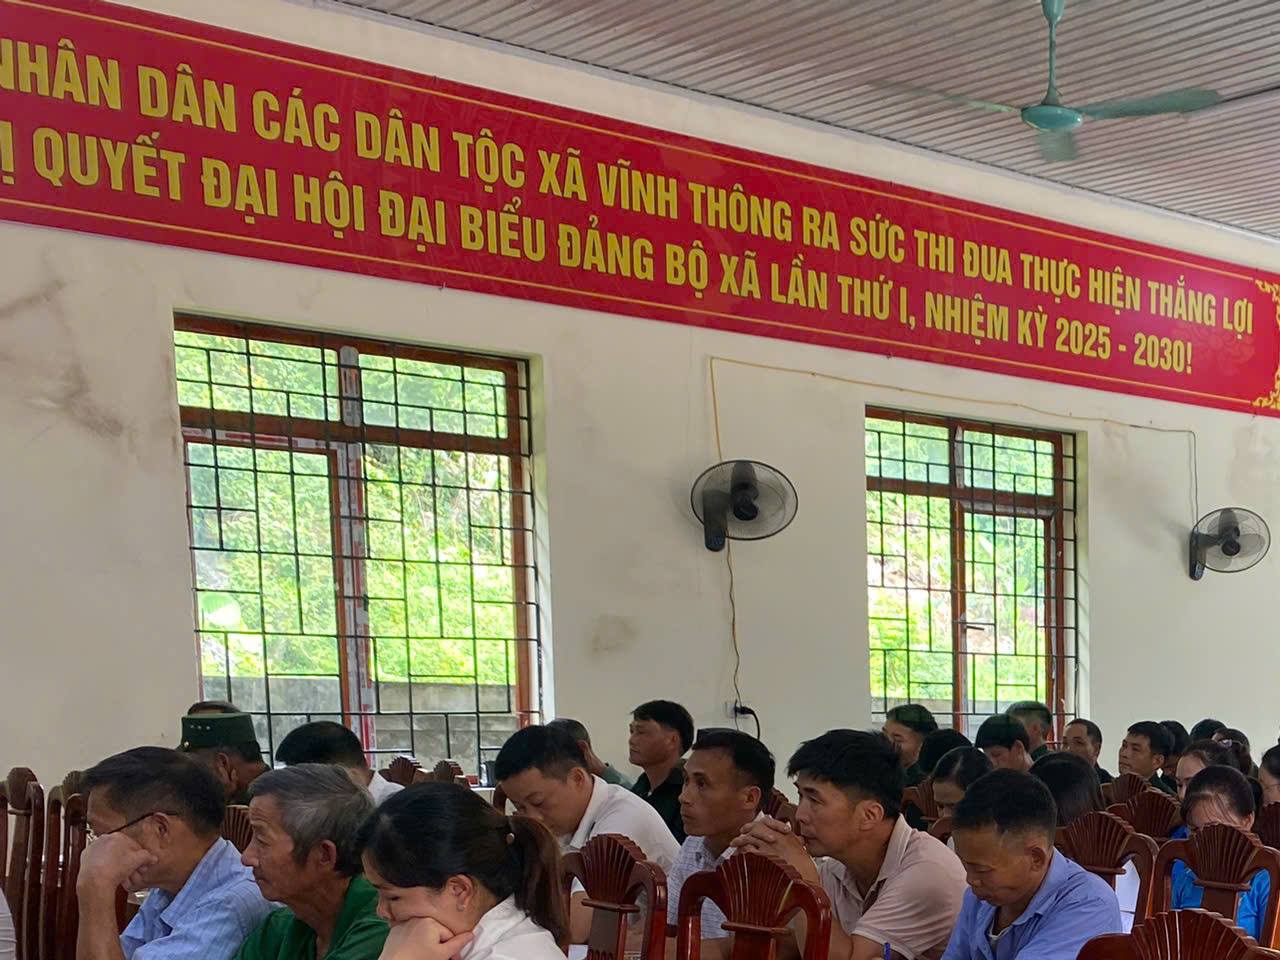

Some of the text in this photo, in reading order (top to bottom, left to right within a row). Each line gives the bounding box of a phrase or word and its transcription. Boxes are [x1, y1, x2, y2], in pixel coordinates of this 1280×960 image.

[33, 130, 186, 202] QUYẾT
[200, 157, 278, 225] ĐẠI
[292, 170, 365, 240] HỘI
[379, 190, 447, 253] ĐẠI
[460, 196, 546, 262] BIỂU
[557, 214, 656, 283] ĐẢNG
[665, 240, 710, 299] BỘ
[719, 252, 761, 300] XÃ
[771, 252, 828, 311] LẦN
[836, 268, 894, 322] THỨ
[899, 286, 917, 330] I,
[924, 292, 1011, 347] NHIỆM
[1017, 307, 1050, 350] KỲ
[1055, 316, 1112, 361] 2025
[1134, 333, 1194, 374] 2030!
[137, 63, 237, 133] DÂN
[252, 87, 341, 152] CÁC
[355, 108, 441, 173] DÂN
[452, 128, 526, 193] TỘC
[538, 147, 587, 202] XÃ
[597, 158, 679, 220] VĨNH
[688, 180, 793, 242] THÔNG
[802, 207, 841, 252] RA
[849, 213, 905, 264] SỨC
[913, 230, 955, 273] THI
[962, 239, 1013, 286] ĐUA
[1020, 254, 1081, 300] THỰC
[1088, 265, 1141, 314] HIỆN
[1148, 275, 1217, 328] THẮNG
[1222, 298, 1253, 336] LỢI
